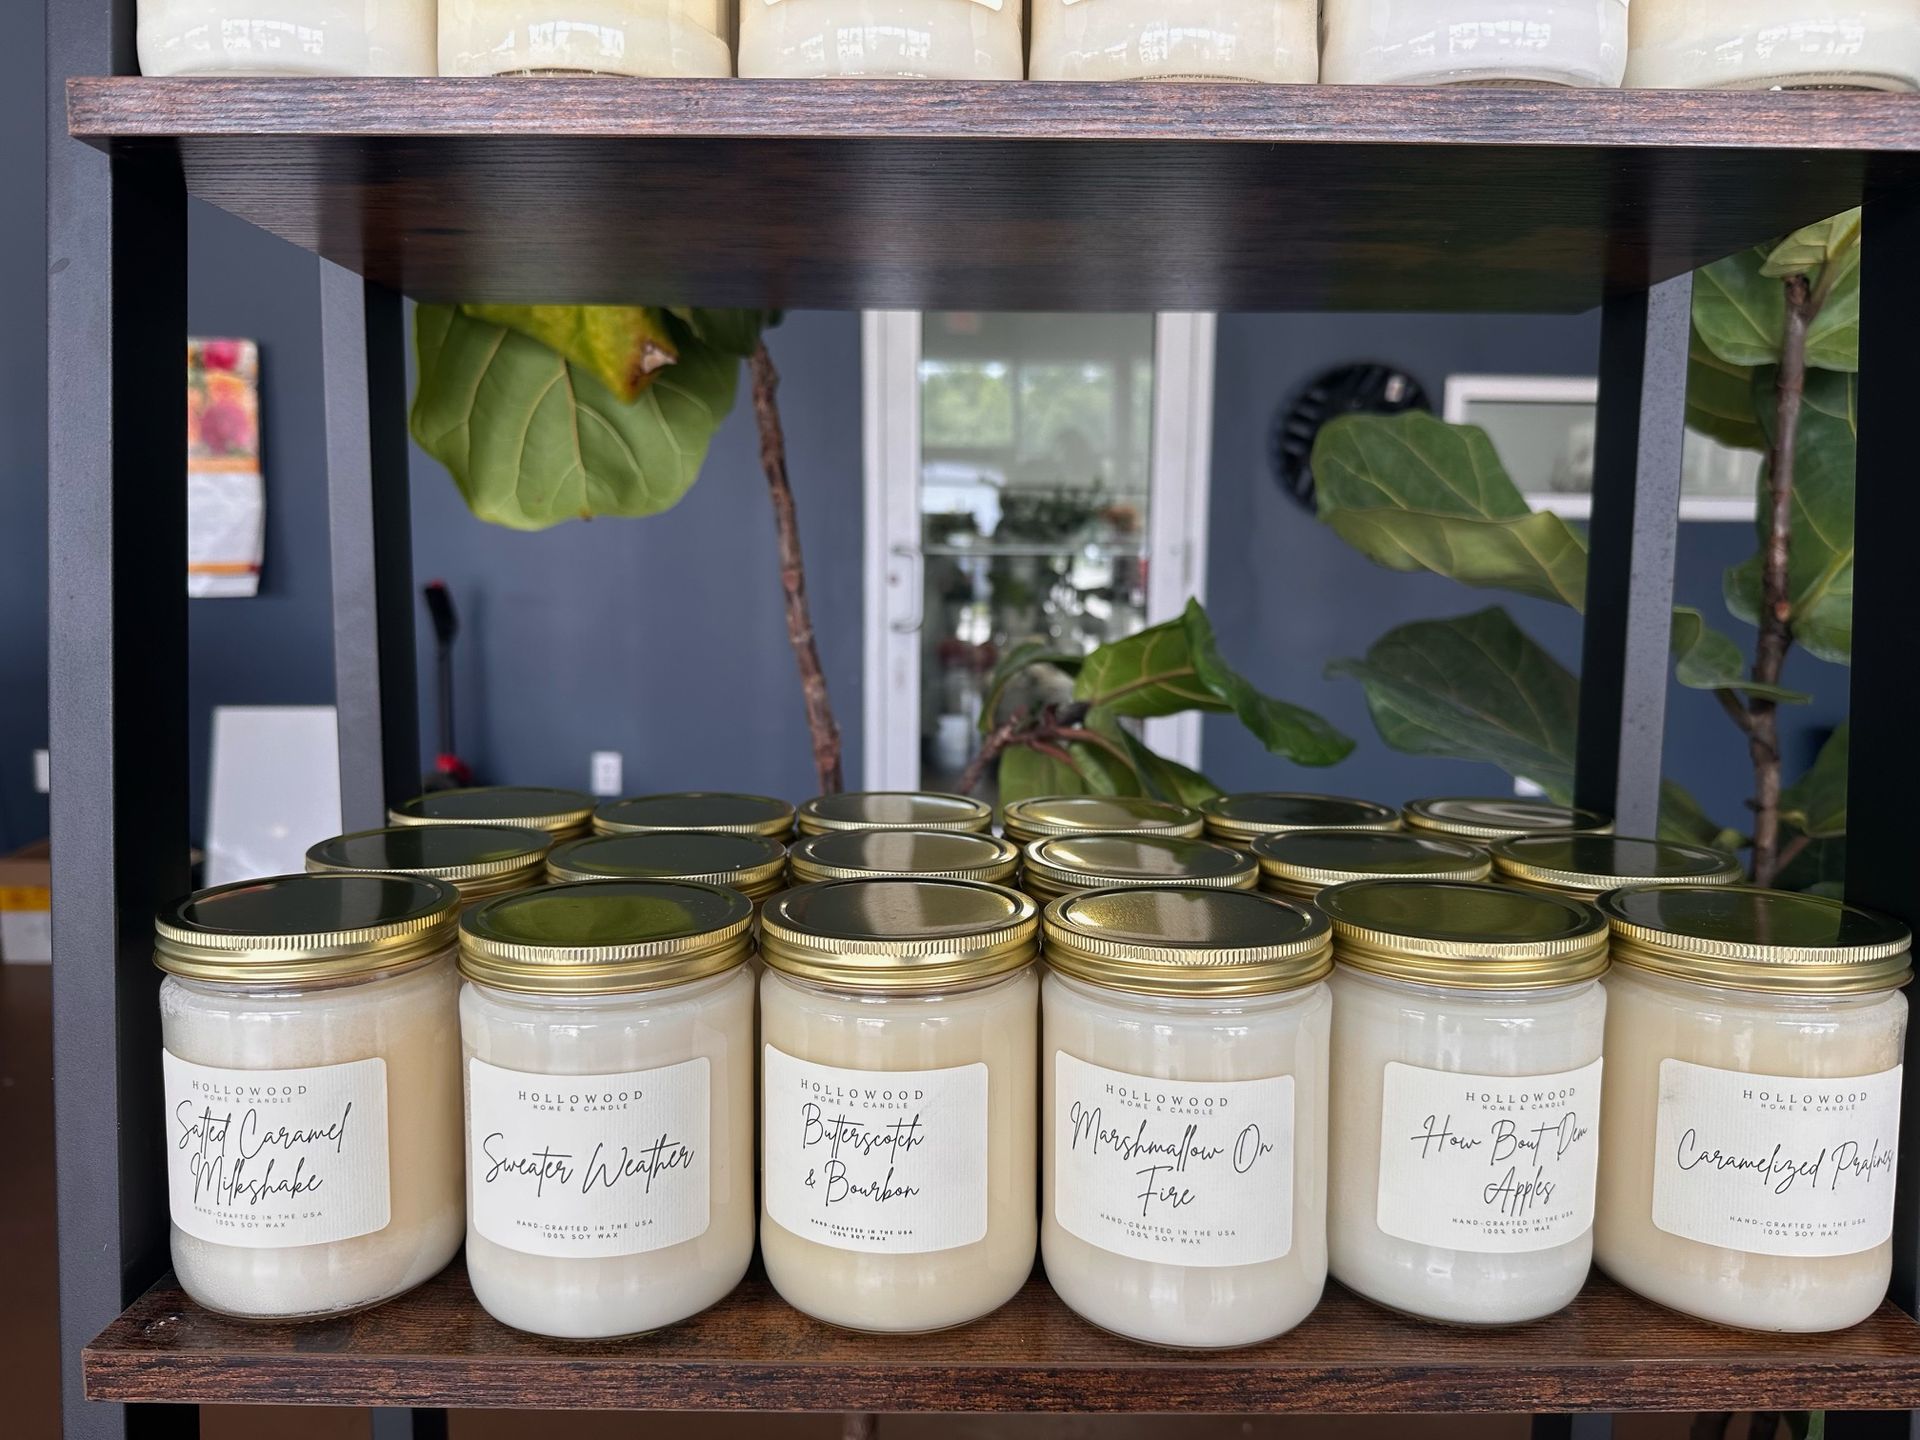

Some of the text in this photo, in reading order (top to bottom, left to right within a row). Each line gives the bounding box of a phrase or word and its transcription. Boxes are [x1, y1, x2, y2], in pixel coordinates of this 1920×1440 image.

[192, 1080, 307, 1095] HOLLOWOOD
[801, 1079, 924, 1101] HOLLOWOOD
[1106, 1084, 1228, 1107] HOLLOWOOD
[1466, 1088, 1575, 1104] HOLLOWOOD
[1743, 1090, 1867, 1104] HOLLOWOOD
[518, 1091, 643, 1104] HOLLOWOOD
[814, 1095, 841, 1105] HOME
[1120, 1099, 1148, 1110] HOME
[1170, 1107, 1214, 1115] CANDLE
[1532, 1101, 1566, 1110] CANDLE
[584, 1103, 628, 1112] CANDLE
[1761, 1103, 1793, 1111] HOME
[1816, 1104, 1855, 1112] CANDLE
[176, 1100, 352, 1159] Salted Caramel
[802, 1102, 924, 1164] Butterscotch
[1070, 1101, 1274, 1173] Marshmallow On
[1410, 1111, 1588, 1166] How Bout Dem
[483, 1132, 695, 1197] Sweater Weather
[1677, 1128, 1826, 1195] Caramelized
[190, 1152, 323, 1206] Milkshake
[804, 1160, 920, 1207] & Bourbon
[1136, 1165, 1195, 1217] Fire
[1484, 1166, 1556, 1217] Apples
[516, 1220, 588, 1232] HAND-CRAFTED
[635, 1219, 654, 1227] USA
[1100, 1213, 1172, 1235] HAND-CRAFTED
[1452, 1218, 1527, 1227] HAND-CRAFTED
[1545, 1215, 1558, 1223] THE
[1730, 1216, 1812, 1229] HAND-CRAFTED
[1851, 1218, 1866, 1226] USA
[1126, 1229, 1149, 1239] 100%
[1155, 1234, 1174, 1242] SOY
